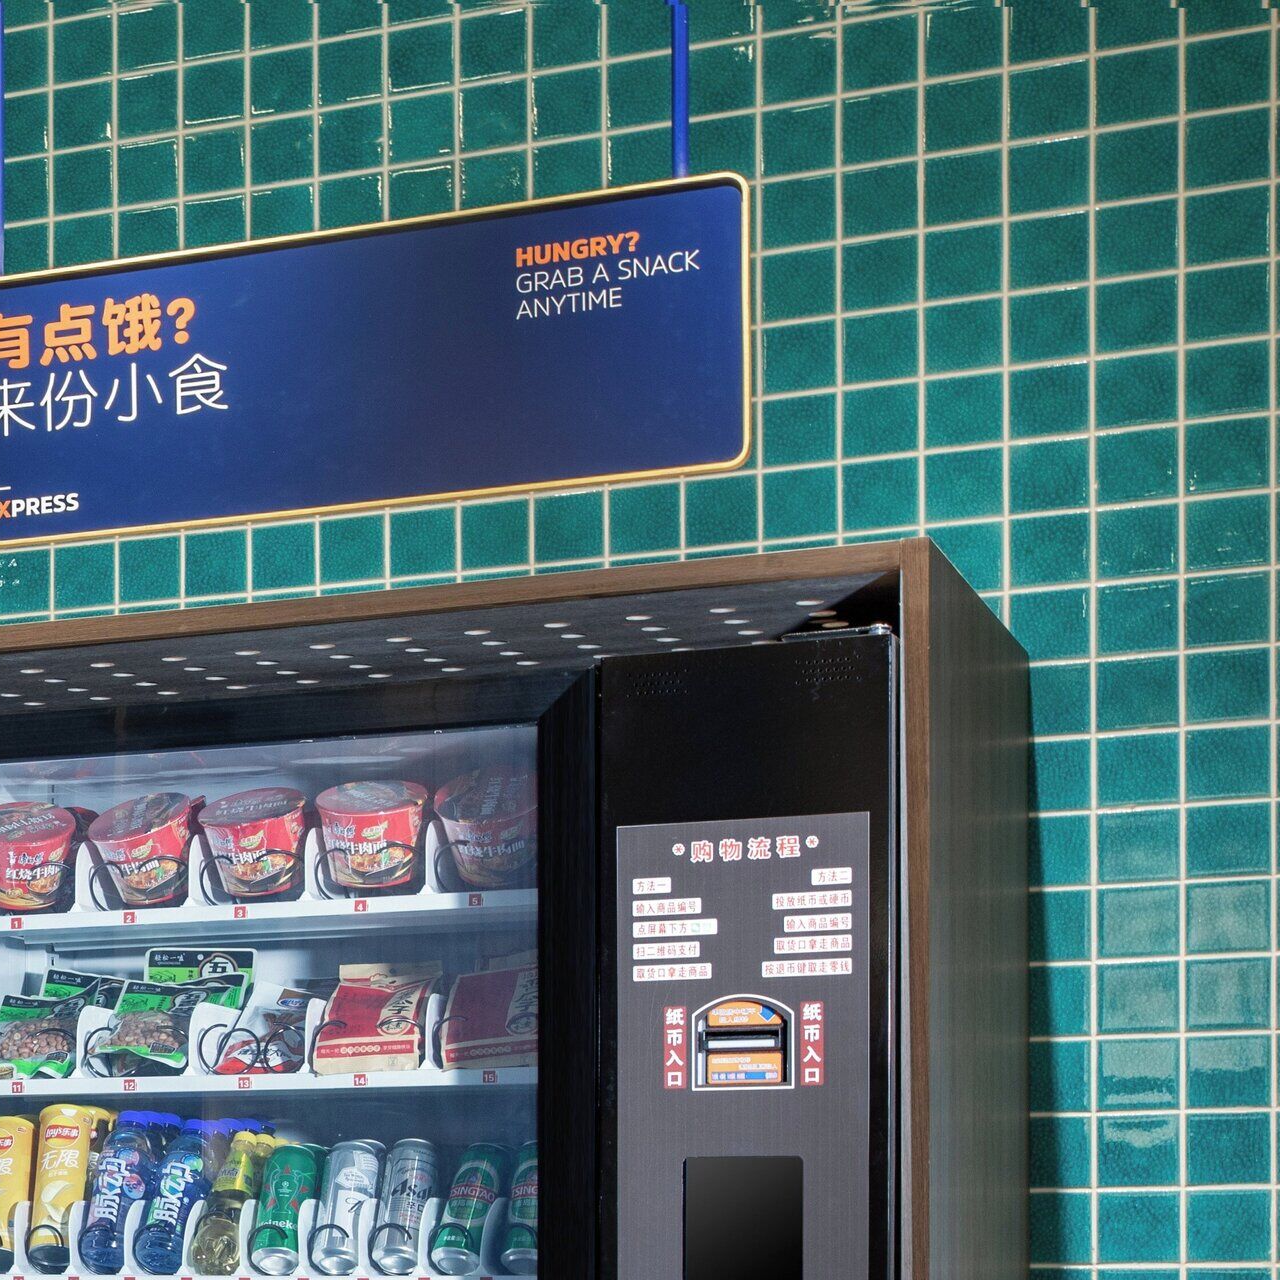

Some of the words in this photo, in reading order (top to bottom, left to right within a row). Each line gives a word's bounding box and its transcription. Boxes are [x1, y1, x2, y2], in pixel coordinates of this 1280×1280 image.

[515, 231, 641, 268] HUNGRY?
[515, 263, 584, 293] GRAB
[592, 262, 610, 285] A
[618, 249, 700, 281] SNACK
[515, 286, 623, 320] ANYTIME
[690, 835, 801, 863] 购物流程
[665, 1008, 684, 1087] 纸币入口
[802, 1003, 822, 1084] 纸币入口
[124, 1082, 135, 1090] 12
[239, 1080, 249, 1088] 13
[354, 1077, 365, 1085] 14
[484, 1074, 495, 1082] 15
[13, 1084, 22, 1092] 11
[41, 1150, 80, 1170] 无限
[450, 1185, 495, 1201] TSINGTAO
[512, 1185, 538, 1196] TSING
